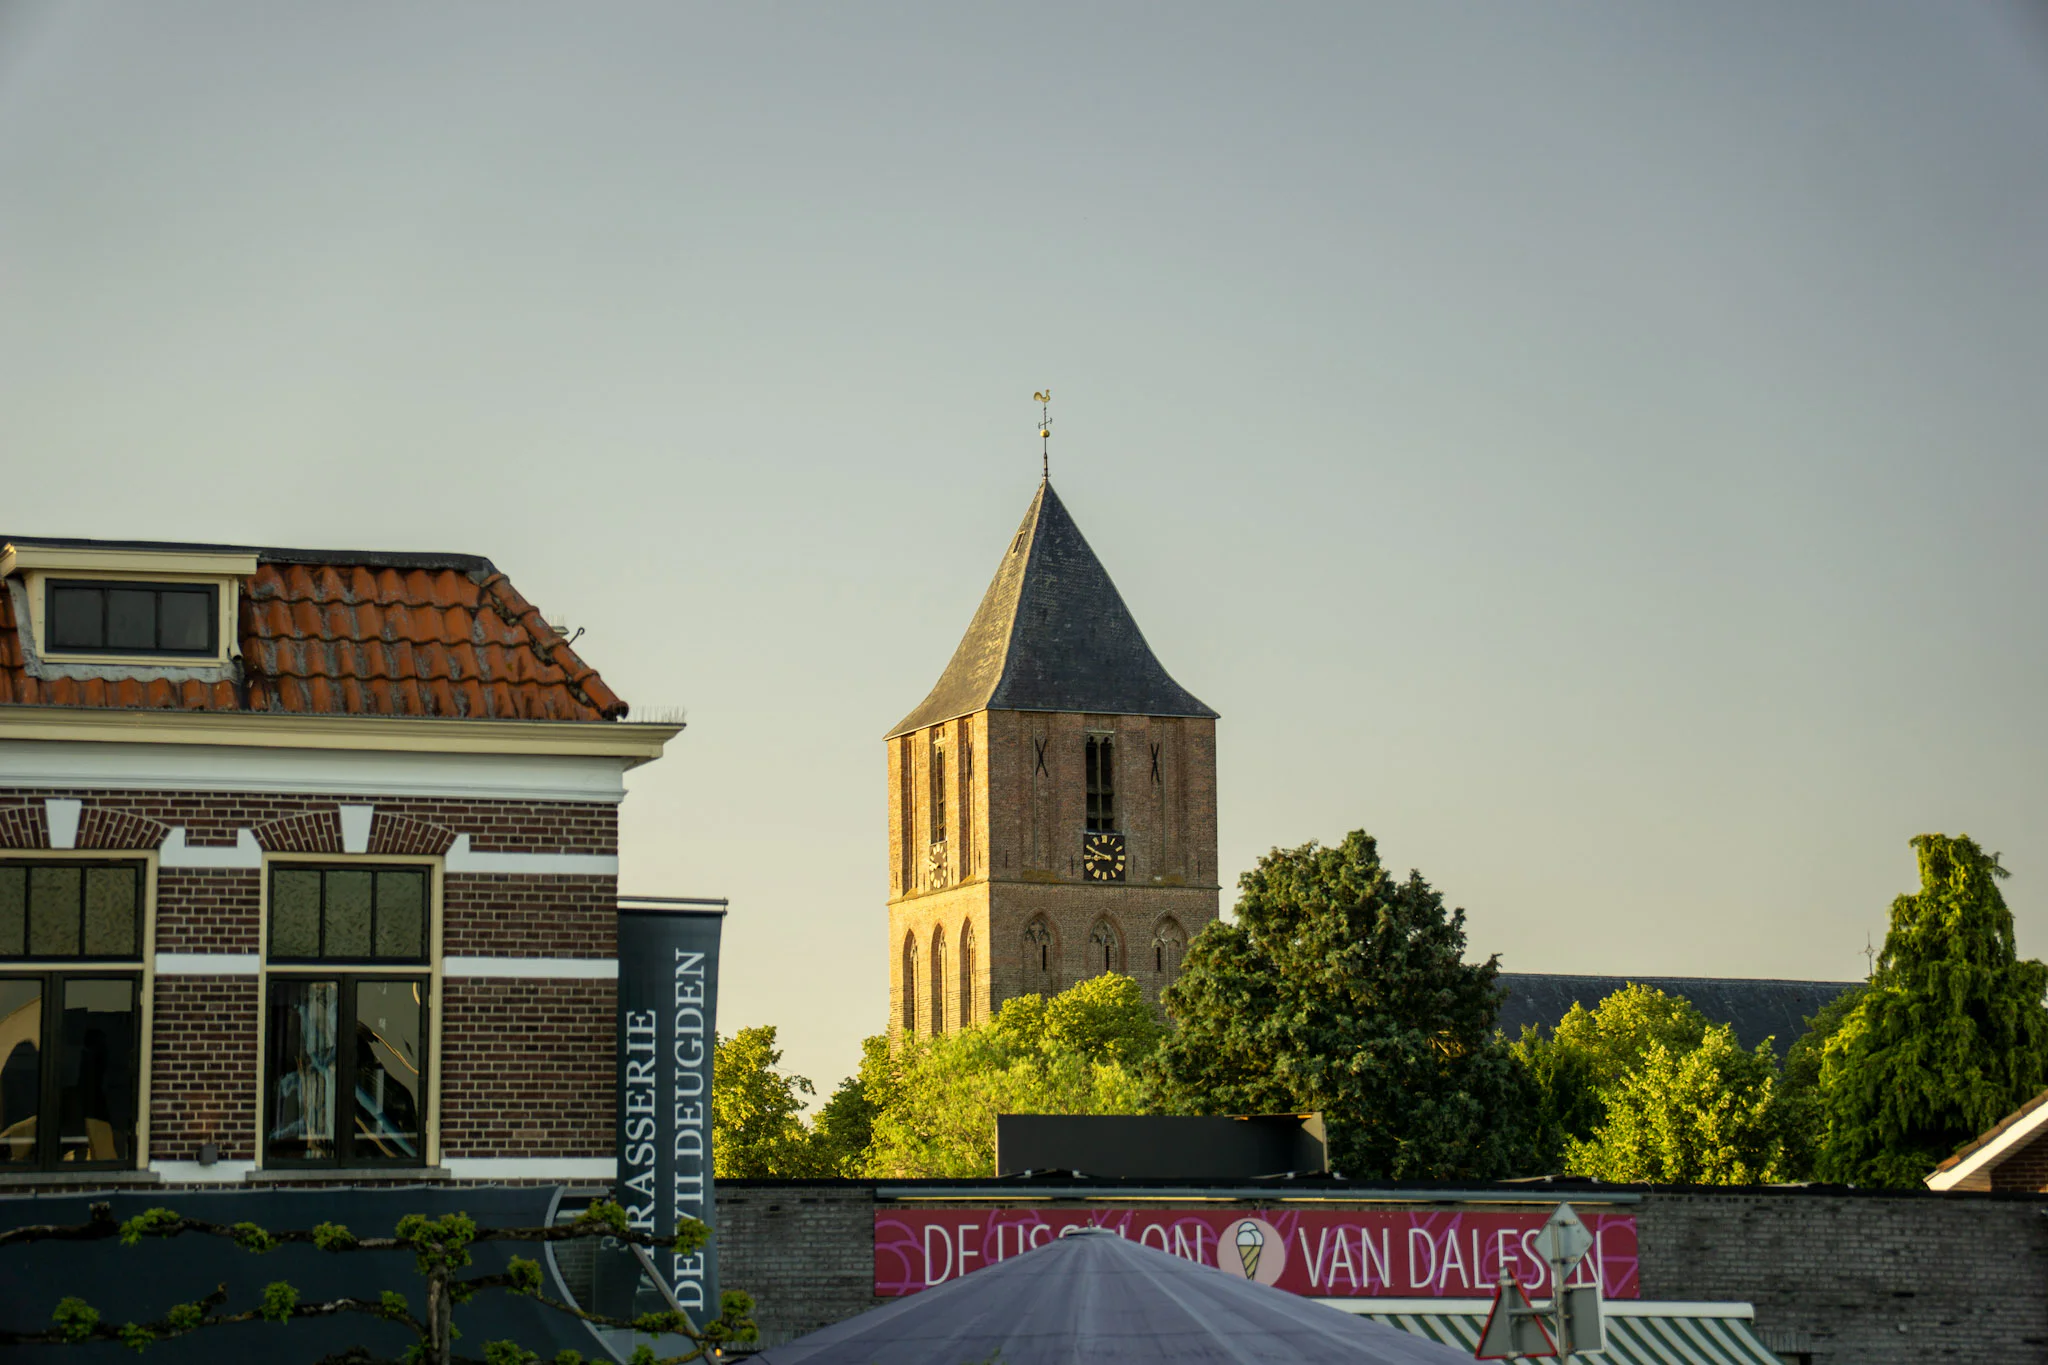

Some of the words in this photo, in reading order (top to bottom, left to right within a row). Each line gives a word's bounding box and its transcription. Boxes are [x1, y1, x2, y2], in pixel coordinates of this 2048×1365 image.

[674, 948, 705, 1160] DEUGDEN
[625, 1010, 656, 1260] RASSERIE
[674, 1251, 704, 1312] DE
[1299, 1228, 1390, 1288] VAN
[1409, 1229, 1602, 1289] DALESN
